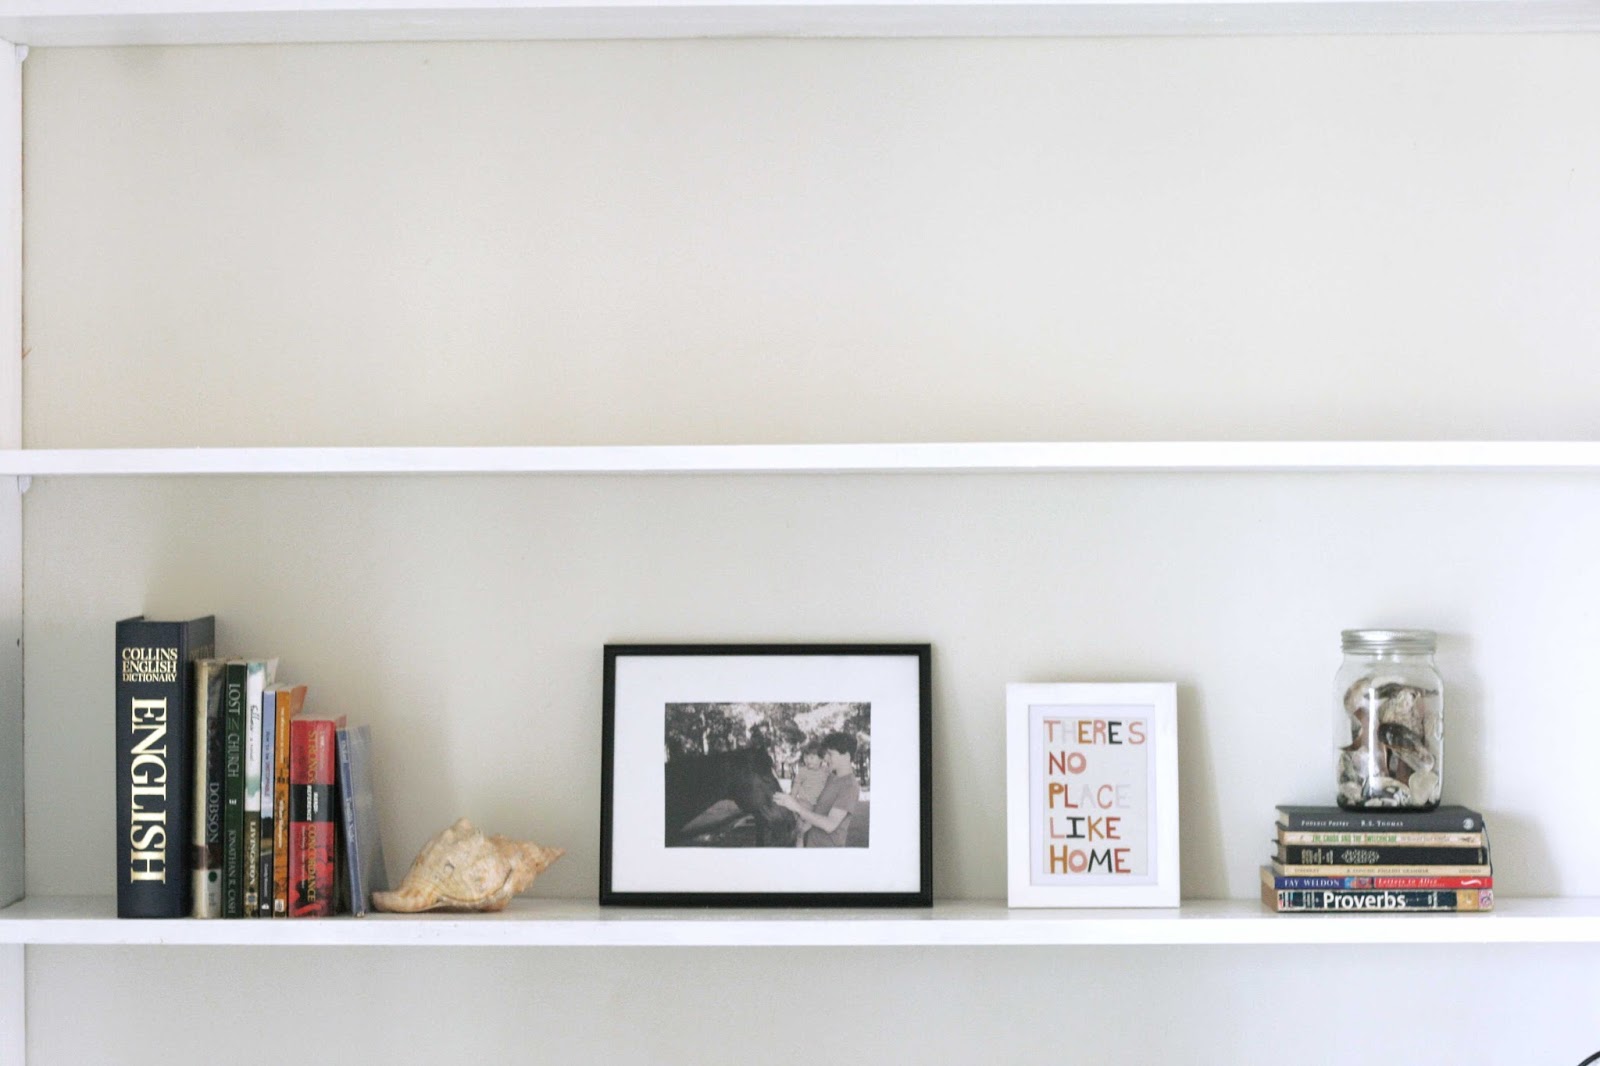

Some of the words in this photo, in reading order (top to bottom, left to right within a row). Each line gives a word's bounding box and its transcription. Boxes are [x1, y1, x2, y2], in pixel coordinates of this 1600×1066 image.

[122, 647, 178, 661] COLLINS
[122, 660, 177, 673] ENGLISH
[122, 673, 177, 682] DICTIONARY
[228, 683, 240, 715] LOST
[227, 733, 239, 777] CHURCH
[1049, 751, 1087, 775] NO
[130, 697, 167, 884] ENGLISH
[1048, 782, 1130, 809] PLACE
[208, 781, 220, 843] DOBSON
[1049, 816, 1121, 842] LIKE
[227, 829, 236, 877] JONATHAN
[307, 824, 316, 902] CONCORDANCE
[1049, 845, 1131, 874] HOME
[1378, 877, 1405, 885] Letters
[1419, 877, 1438, 885] Alice
[227, 889, 236, 914] CASH
[1323, 891, 1406, 910] Proverbs
